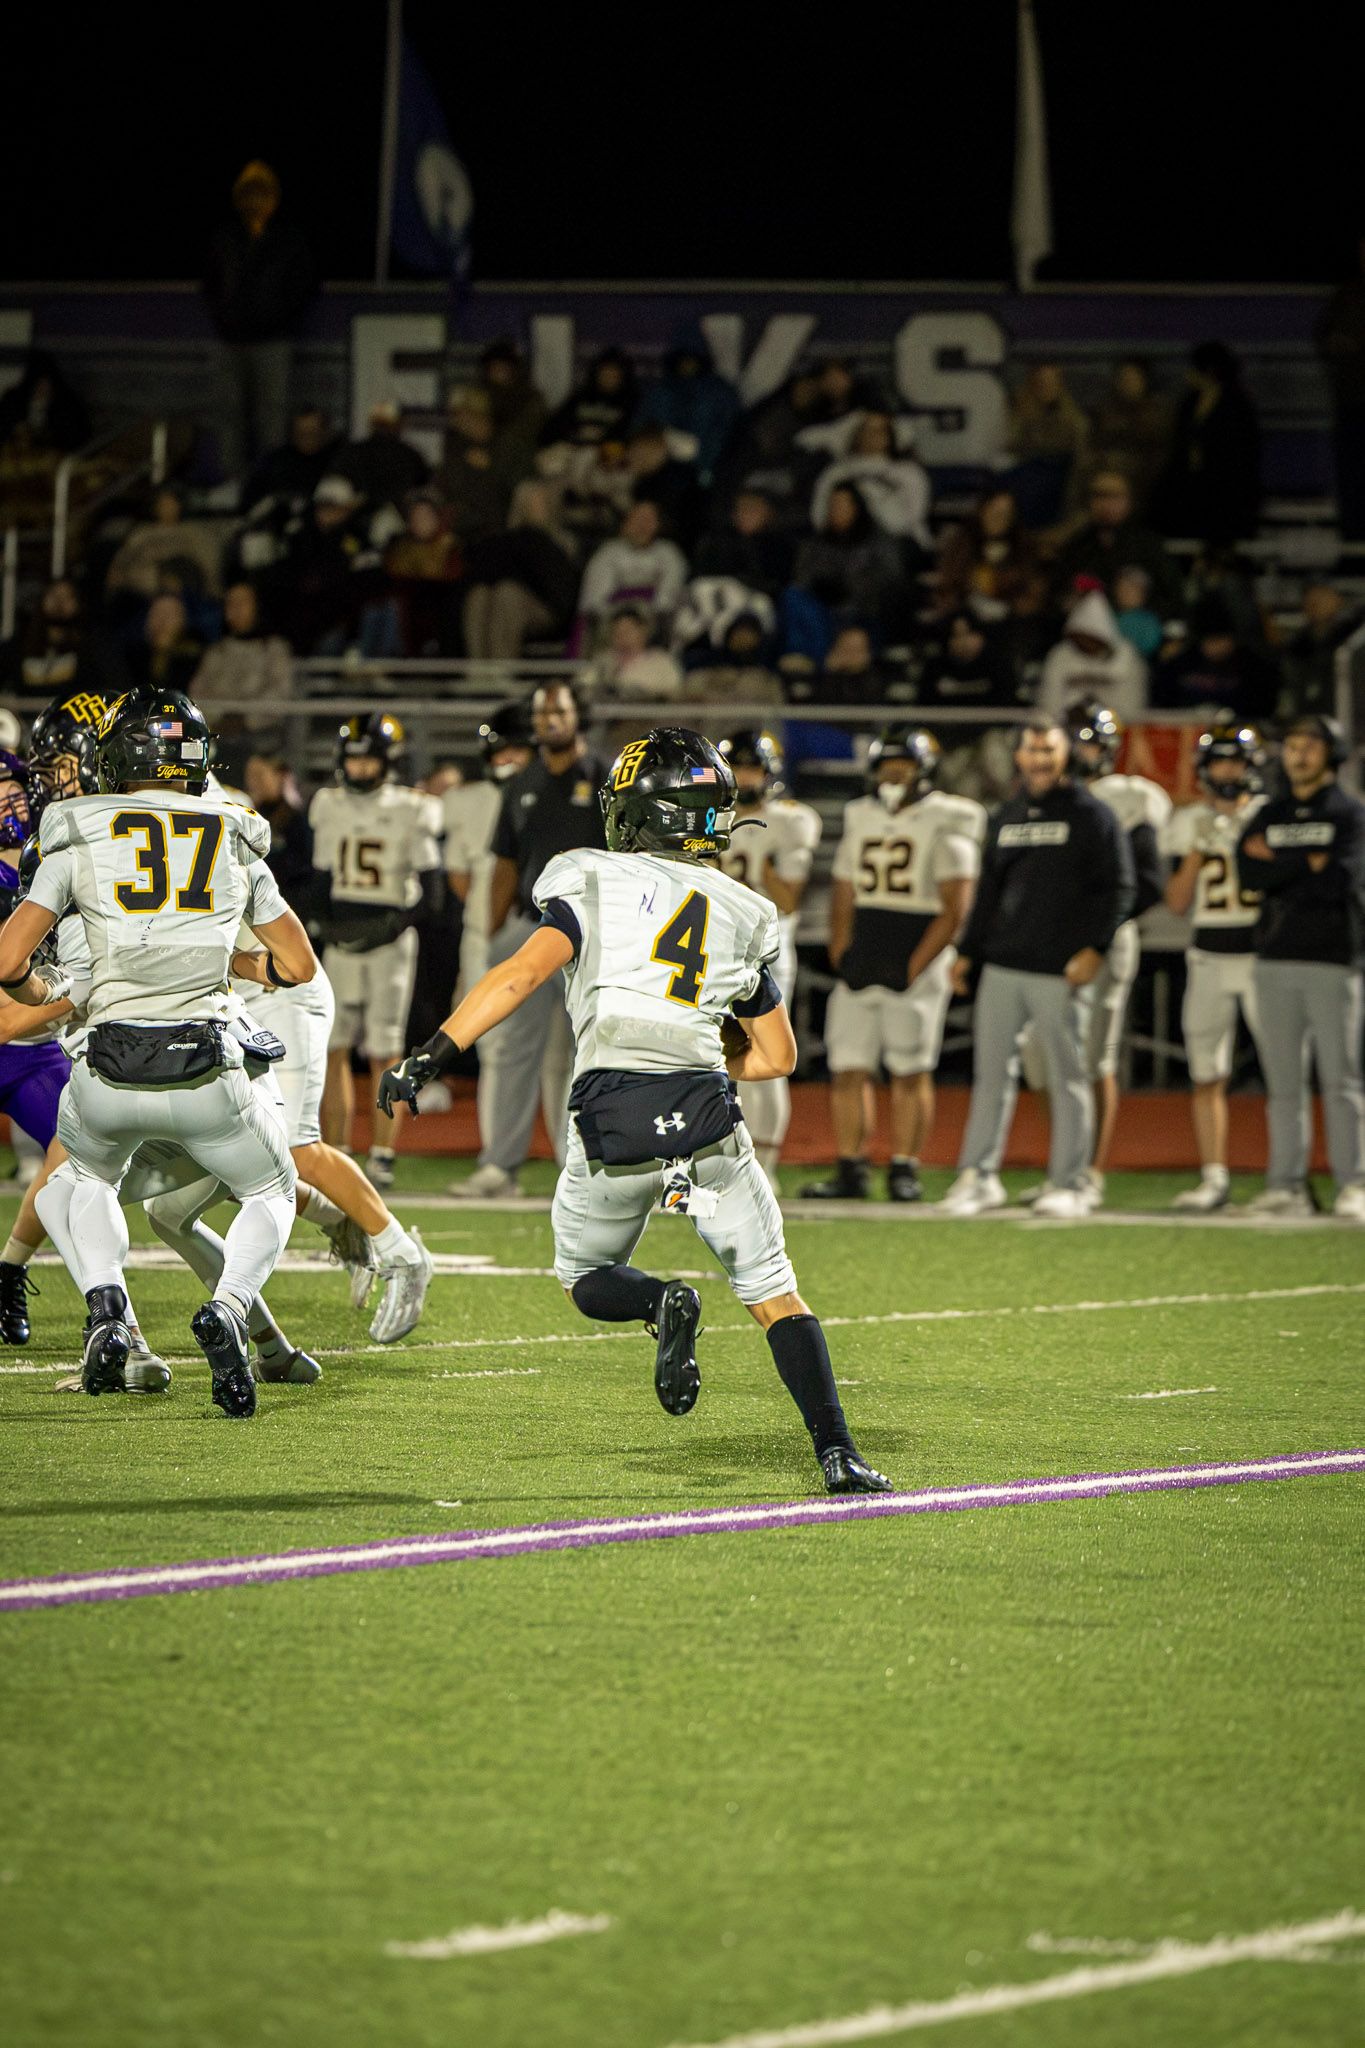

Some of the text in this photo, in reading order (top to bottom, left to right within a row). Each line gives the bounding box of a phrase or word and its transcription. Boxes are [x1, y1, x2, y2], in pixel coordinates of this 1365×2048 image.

[162, 705, 176, 714] 37
[157, 764, 189, 780] Tigers
[110, 811, 225, 914] 37
[338, 836, 384, 889] 15
[683, 838, 717, 853] Tigers
[859, 837, 914, 893] 52
[651, 889, 709, 1008] 4
